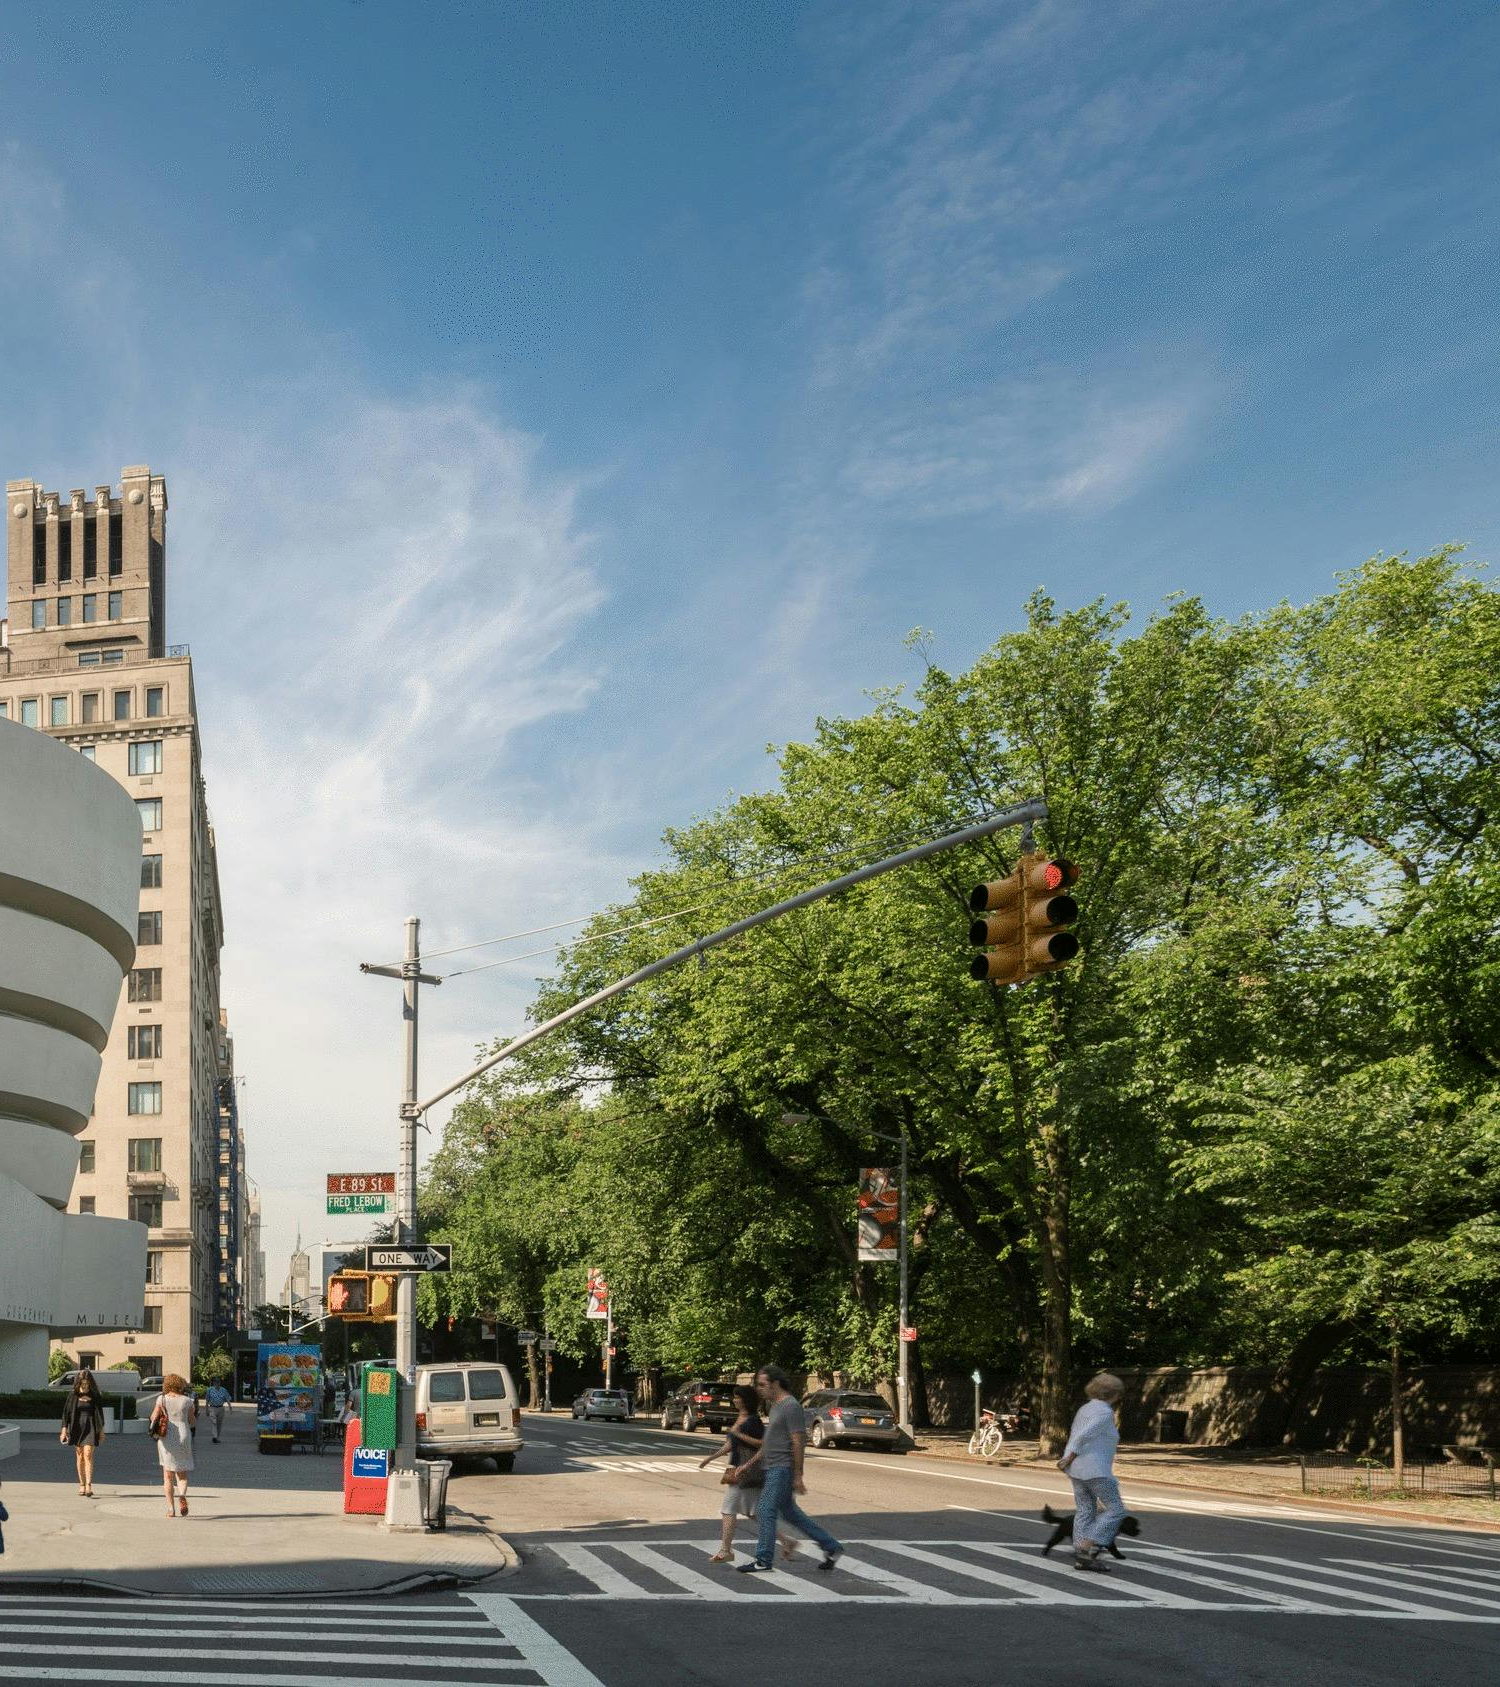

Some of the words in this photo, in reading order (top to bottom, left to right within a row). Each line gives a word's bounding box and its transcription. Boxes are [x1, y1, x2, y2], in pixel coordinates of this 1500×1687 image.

[340, 1178, 346, 1191] E
[351, 1178, 365, 1192] 89
[371, 1177, 383, 1191] St
[328, 1196, 350, 1207] FRED
[354, 1195, 383, 1206] LEBOW
[378, 1253, 403, 1264] ONE
[413, 1253, 438, 1264] WAY
[356, 1448, 386, 1460] VOICE
